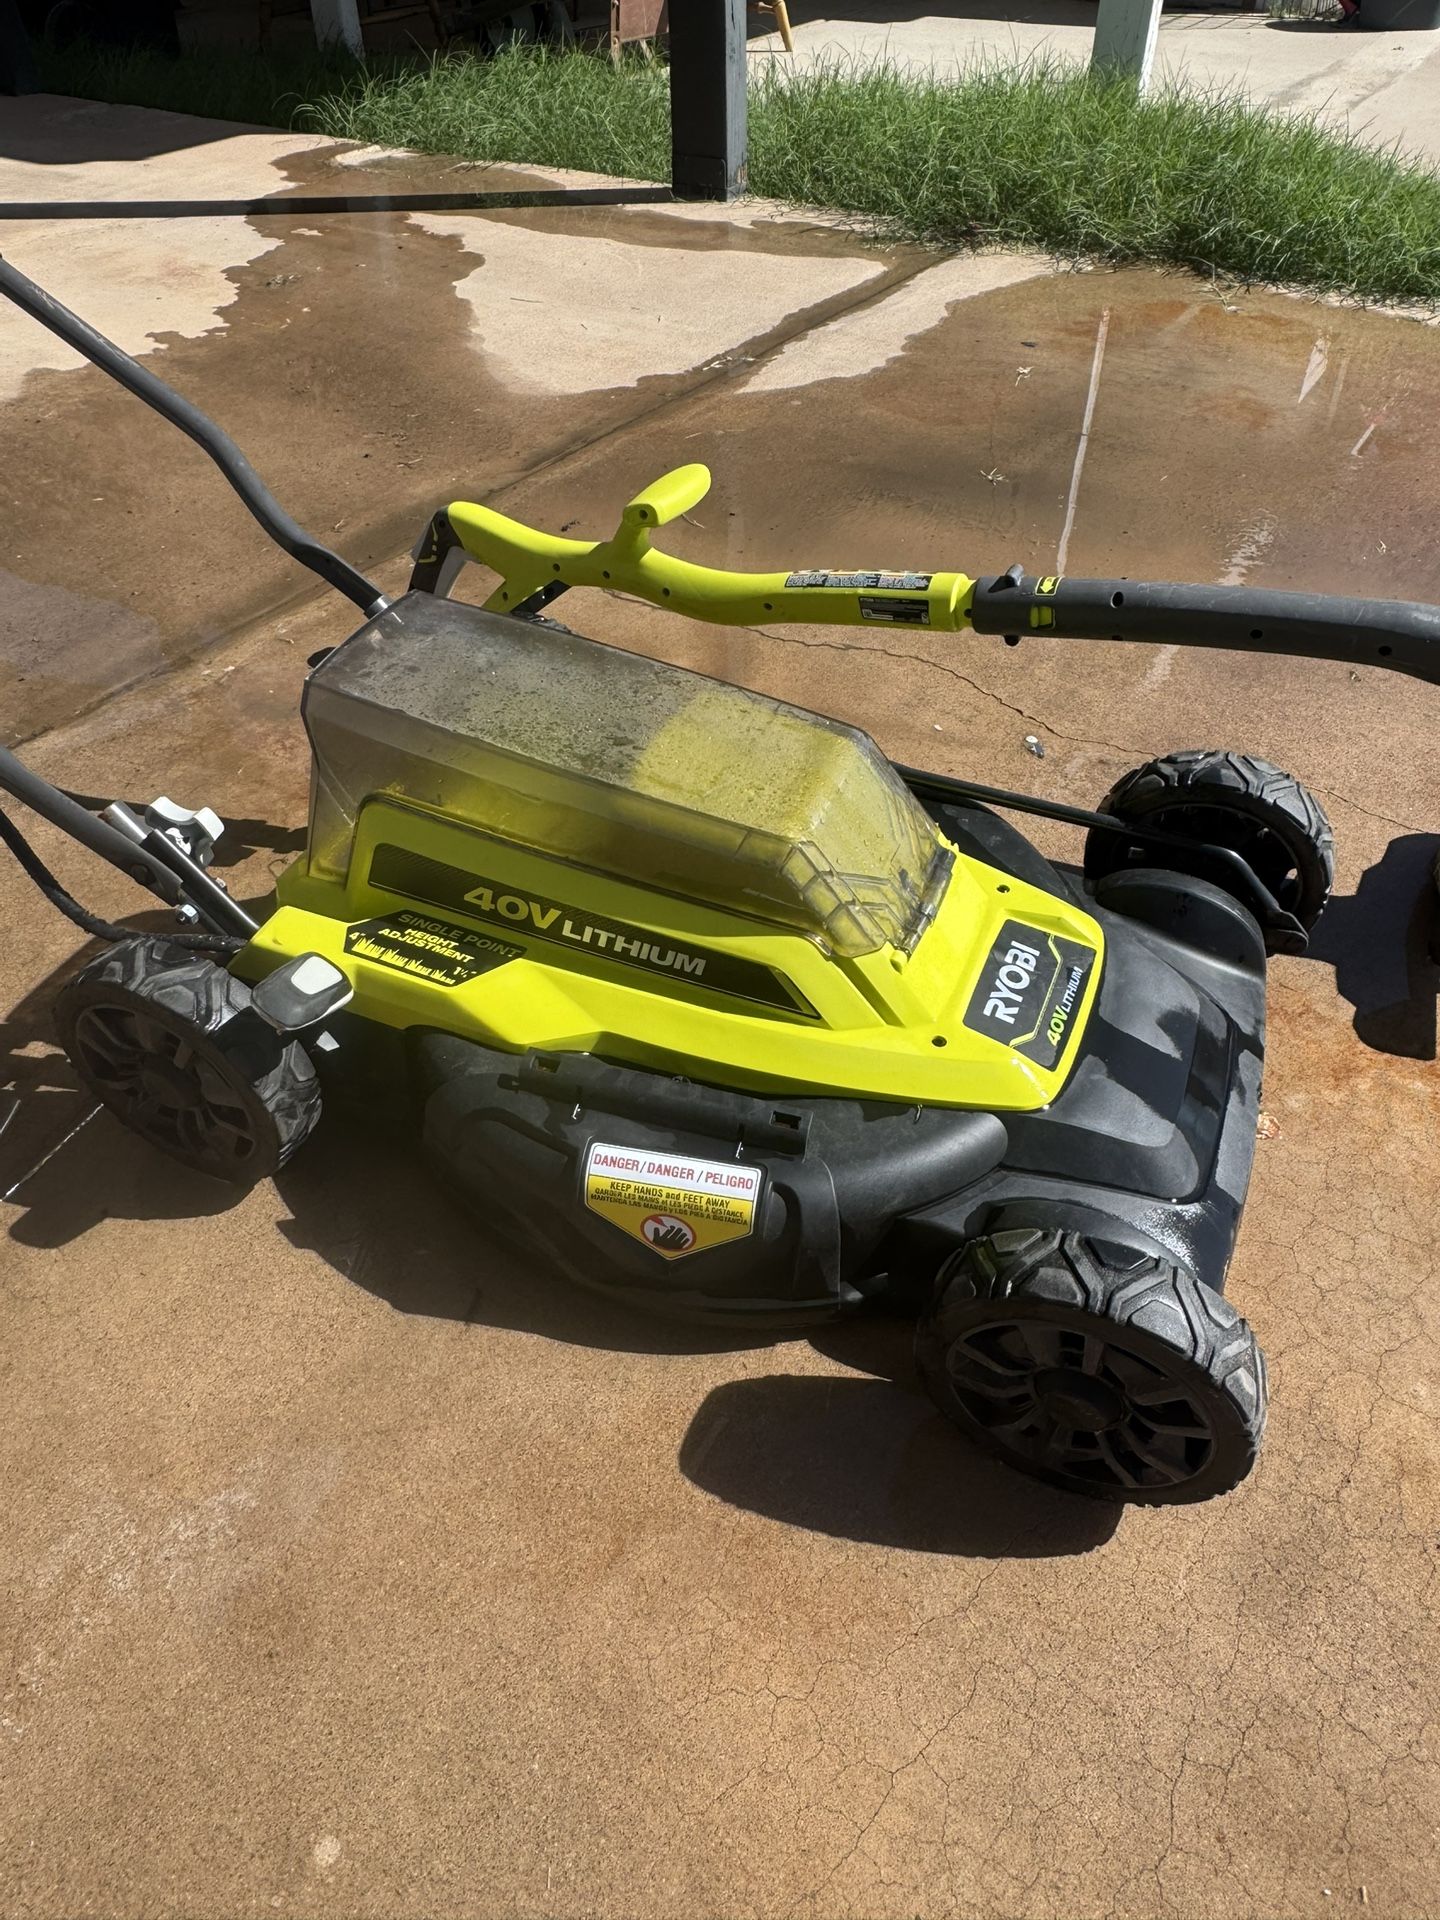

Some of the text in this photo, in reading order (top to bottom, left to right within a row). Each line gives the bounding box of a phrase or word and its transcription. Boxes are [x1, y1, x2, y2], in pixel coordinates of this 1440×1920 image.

[378, 928, 475, 963] ADJUSTMENT
[398, 913, 522, 958] SINGLE POINT
[404, 928, 459, 949] HEIGHT
[464, 886, 707, 976] 40V LITHIUM
[983, 941, 1041, 1025] RYOBI
[1046, 966, 1084, 1046] 40V LITHIUM
[593, 1153, 640, 1172] DANGER
[647, 1162, 695, 1181] DANGER
[705, 1171, 754, 1190] PELIGRO
[610, 1181, 730, 1209] KEEP HANDS and FEET AWAY
[638, 1195, 660, 1204] MAINS
[669, 1199, 681, 1208] LES
[711, 1208, 744, 1219] DISTANCE
[712, 1213, 748, 1226] DISTANCIA
